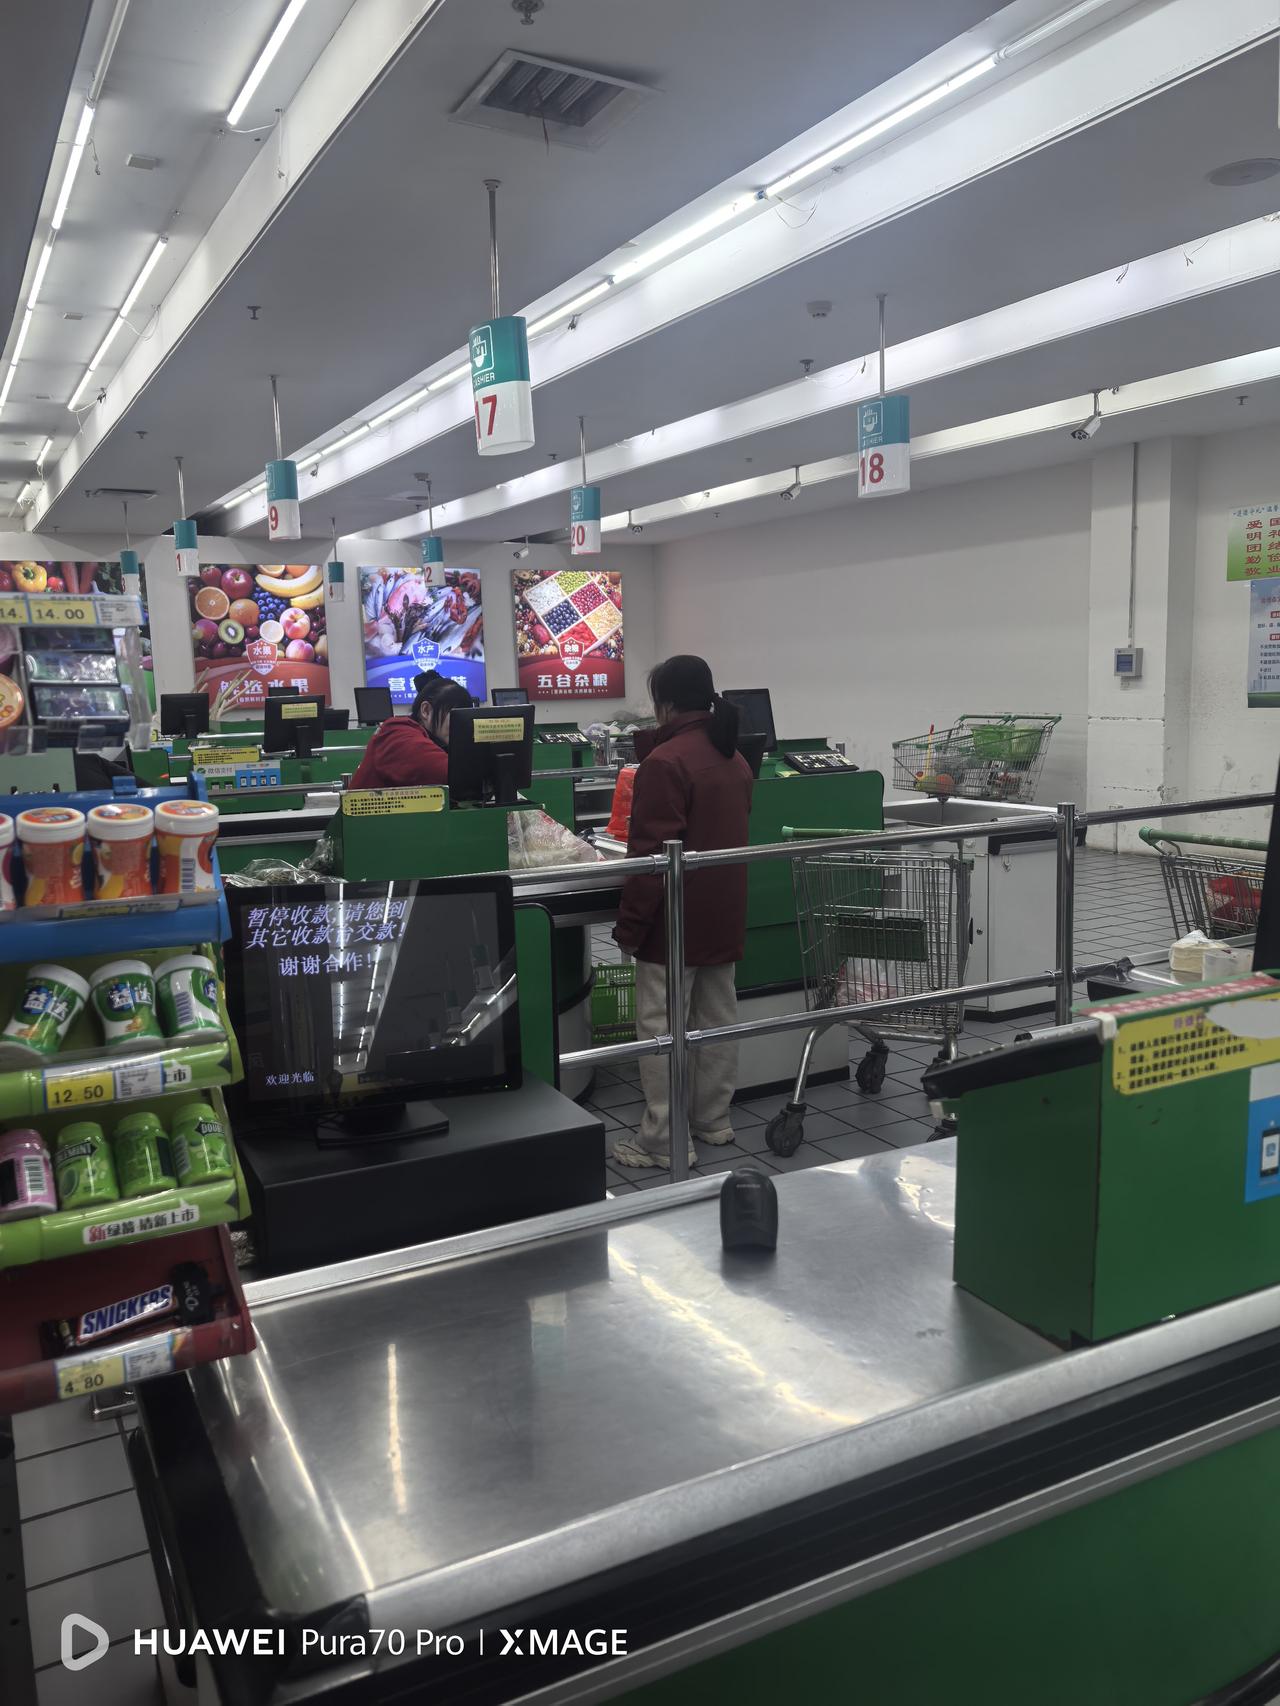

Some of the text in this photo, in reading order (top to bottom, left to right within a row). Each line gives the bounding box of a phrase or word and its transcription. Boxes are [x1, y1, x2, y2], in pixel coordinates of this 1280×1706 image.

[475, 394, 498, 440] 17
[860, 452, 885, 487] 18
[253, 645, 272, 656] 水果
[417, 645, 434, 654] 水产
[537, 673, 608, 688] 五谷杂粮
[265, 1071, 315, 1086] 欢迎光临
[82, 1286, 172, 1336] SNICKERS
